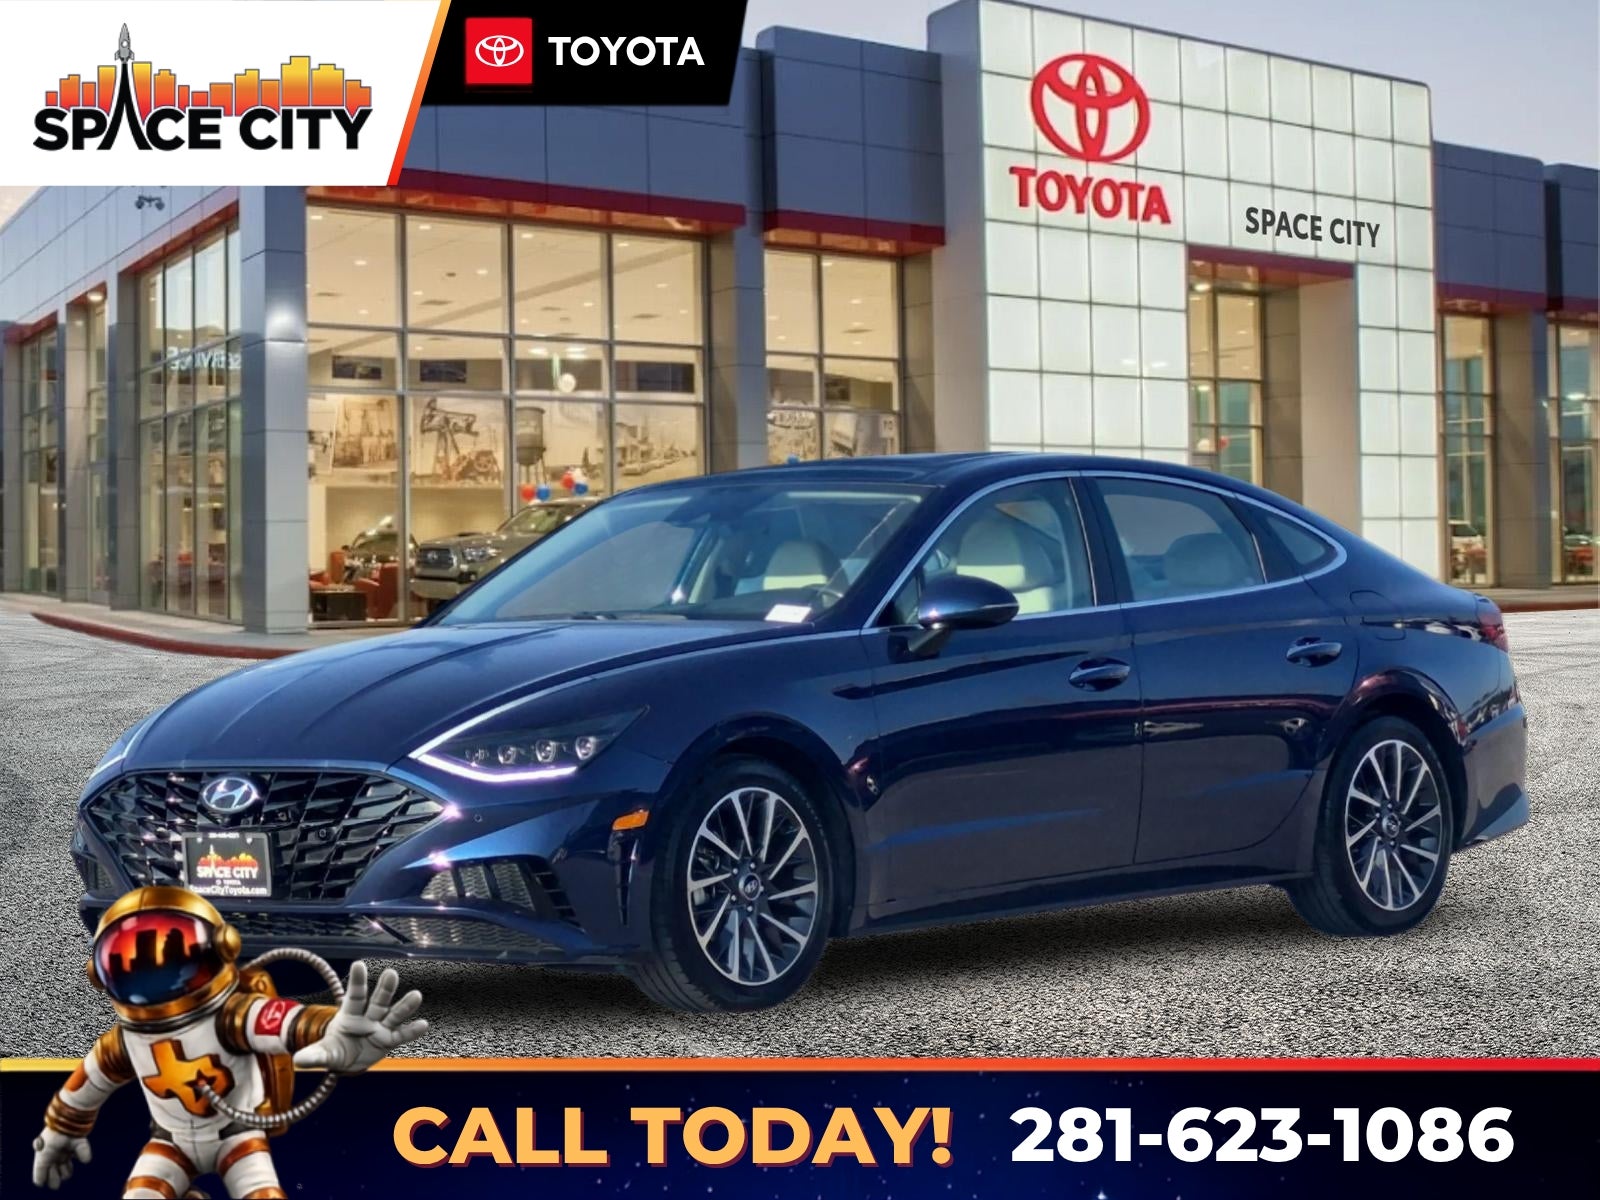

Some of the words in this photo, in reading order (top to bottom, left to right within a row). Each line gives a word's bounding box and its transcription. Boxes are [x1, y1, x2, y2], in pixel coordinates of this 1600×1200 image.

[1009, 166, 1171, 224] TOYOTA
[1245, 206, 1322, 241] SPACE
[1329, 218, 1380, 248] CITY
[196, 866, 232, 878] SPACE
[232, 866, 259, 879] CITY
